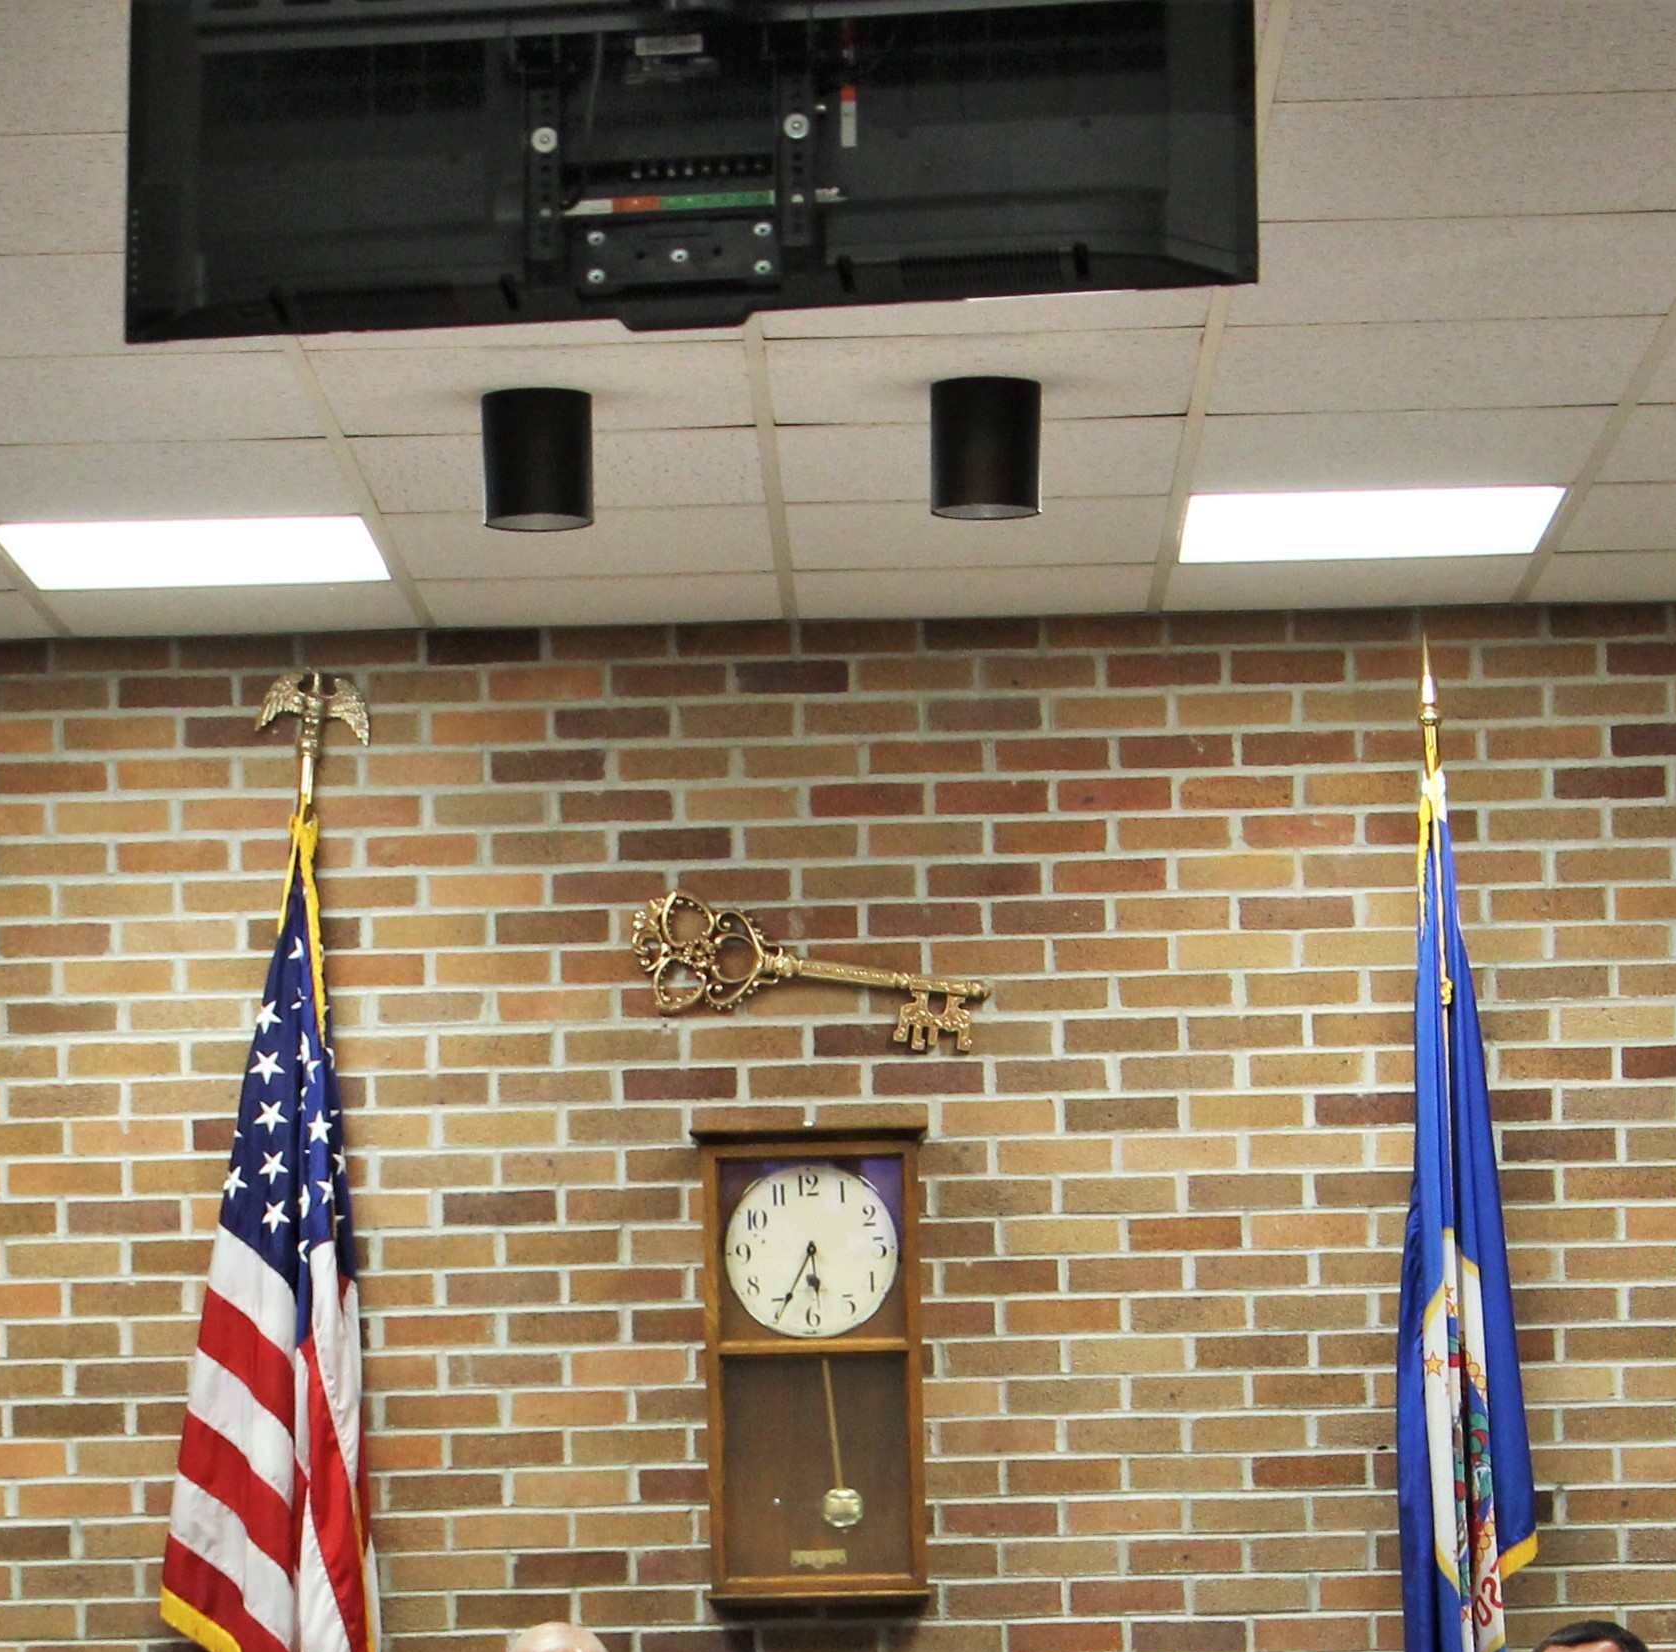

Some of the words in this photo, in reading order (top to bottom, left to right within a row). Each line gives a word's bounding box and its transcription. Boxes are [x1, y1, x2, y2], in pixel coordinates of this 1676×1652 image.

[772, 1184, 785, 1206] 11
[798, 1174, 819, 1196] 12
[747, 1209, 767, 1230] 10
[862, 1204, 876, 1227] 2
[735, 1243, 751, 1265] 9
[747, 1275, 760, 1296] 8
[805, 1306, 821, 1327] 6
